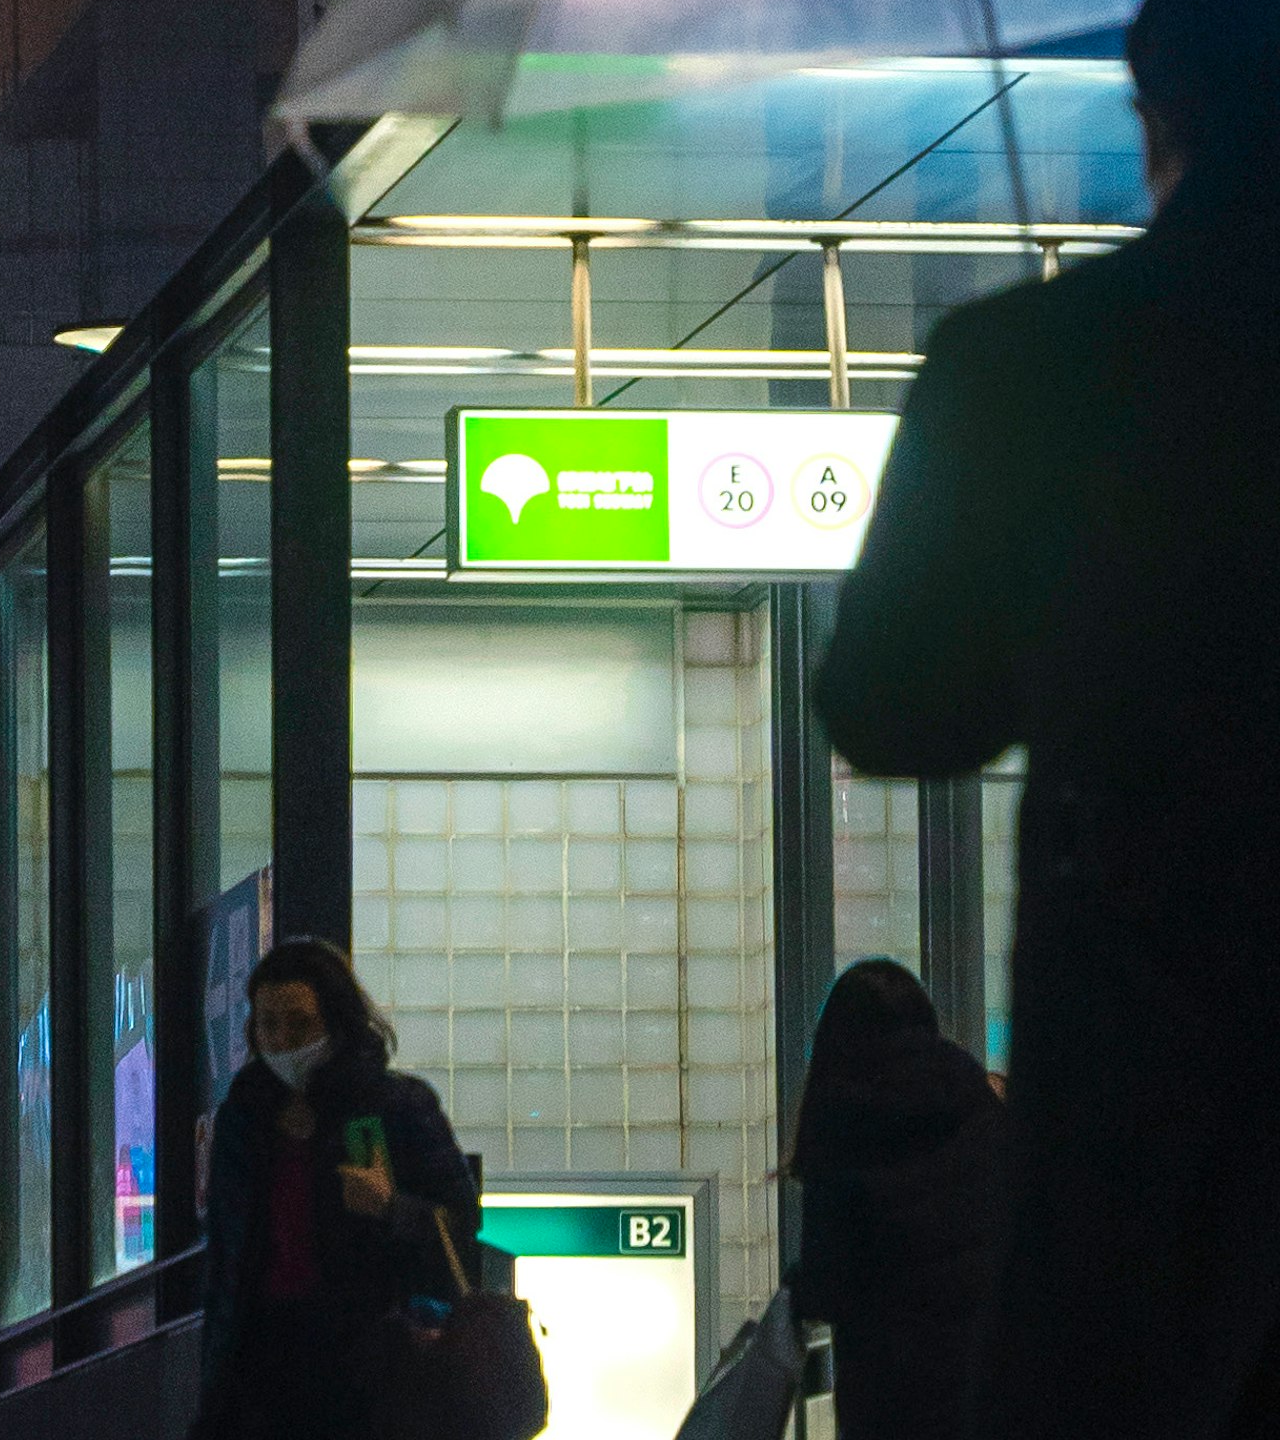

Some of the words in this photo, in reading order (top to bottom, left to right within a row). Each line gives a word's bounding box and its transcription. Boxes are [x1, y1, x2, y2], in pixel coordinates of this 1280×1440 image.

[730, 465, 742, 484] E
[820, 466, 838, 485] A
[720, 491, 754, 513] 20
[811, 491, 847, 513] 09
[628, 1217, 672, 1247] B2
